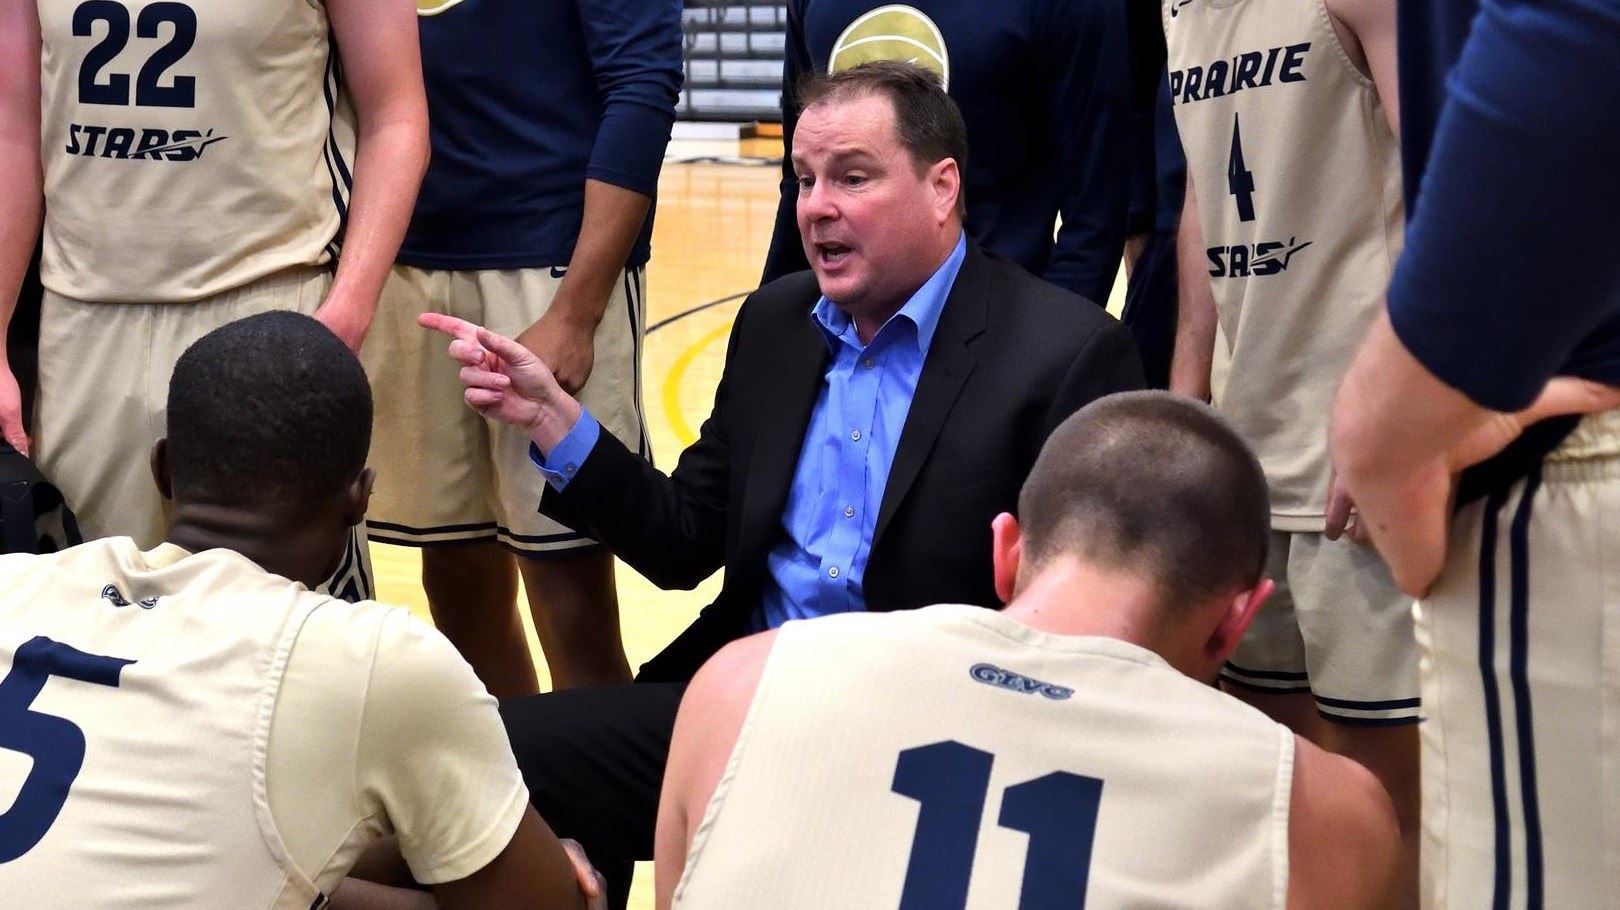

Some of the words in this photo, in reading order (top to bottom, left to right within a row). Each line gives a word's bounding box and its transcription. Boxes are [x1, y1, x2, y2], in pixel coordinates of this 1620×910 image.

[72, 0, 197, 107] 22
[1170, 42, 1311, 105] PRAIRIE
[66, 124, 203, 161] STARS
[1228, 112, 1255, 222] 4
[0, 635, 137, 864] 5
[891, 740, 1104, 910] 11
